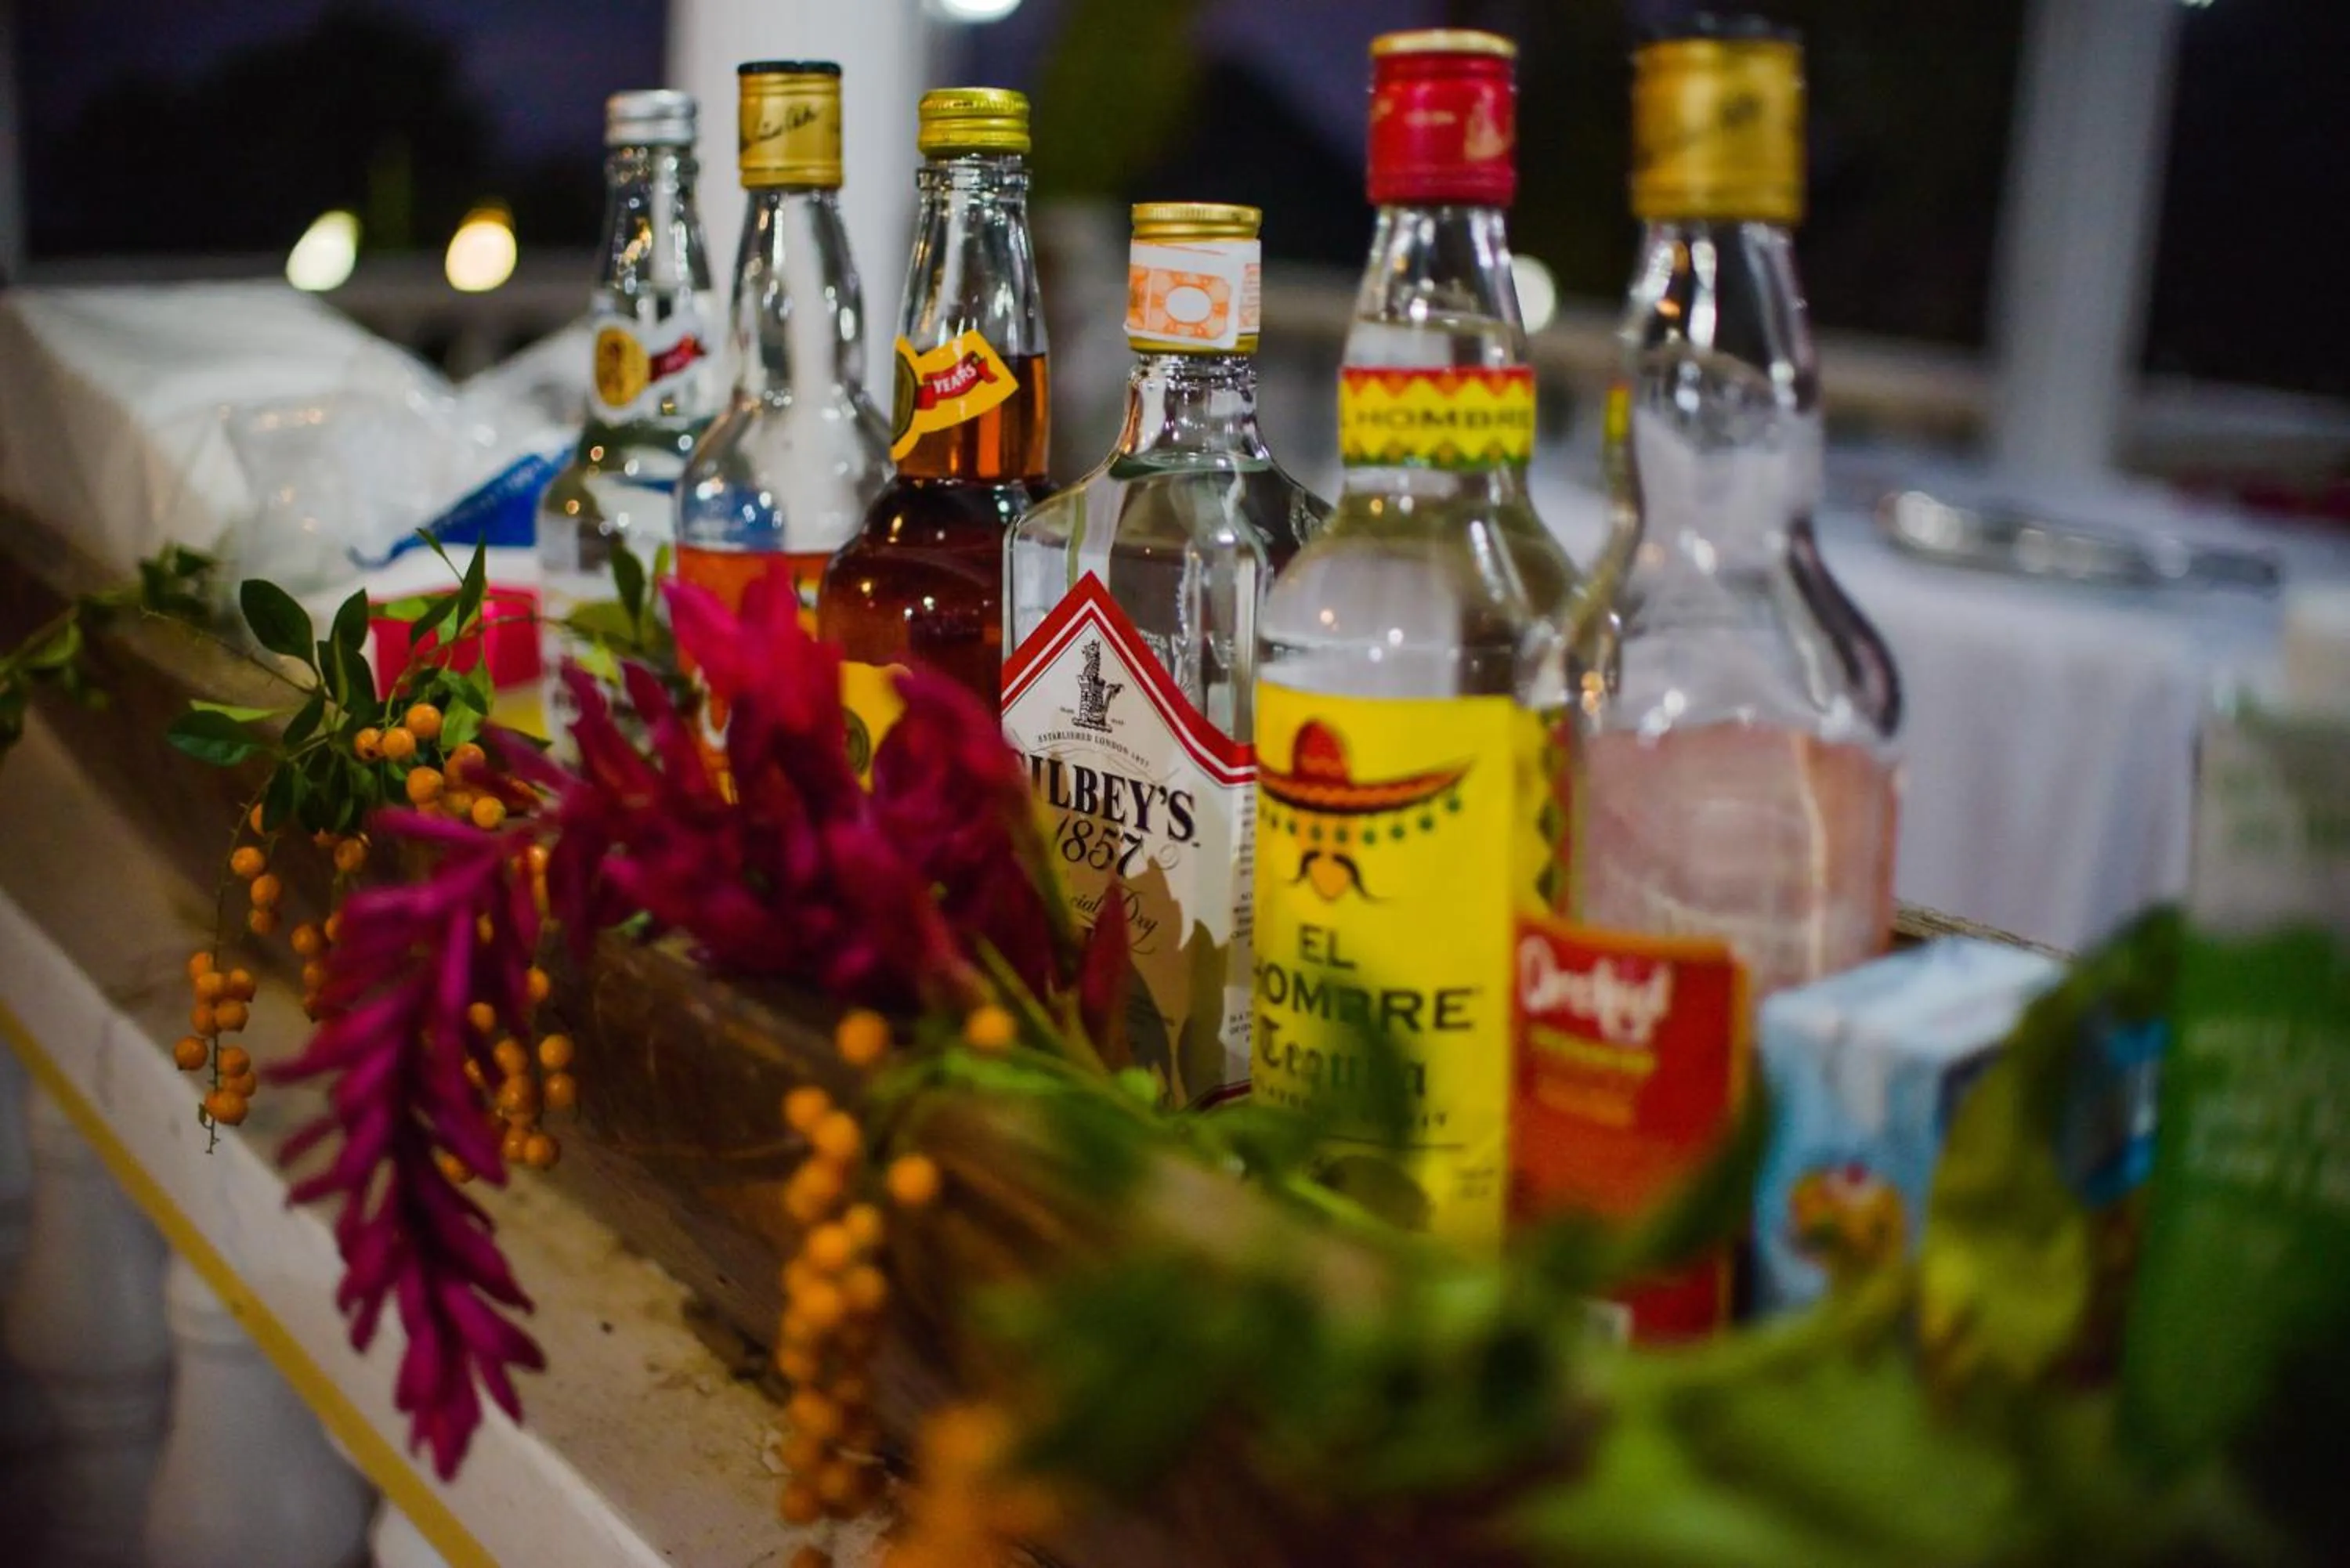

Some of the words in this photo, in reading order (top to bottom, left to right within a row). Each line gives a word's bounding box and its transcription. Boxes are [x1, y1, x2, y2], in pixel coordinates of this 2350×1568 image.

[933, 363, 978, 394] YEARS
[1038, 731, 1093, 742] ESTABLISHED
[1094, 735, 1129, 754] LONDON
[1300, 924, 1358, 970] EL
[1254, 960, 1477, 1032] OMBRE
